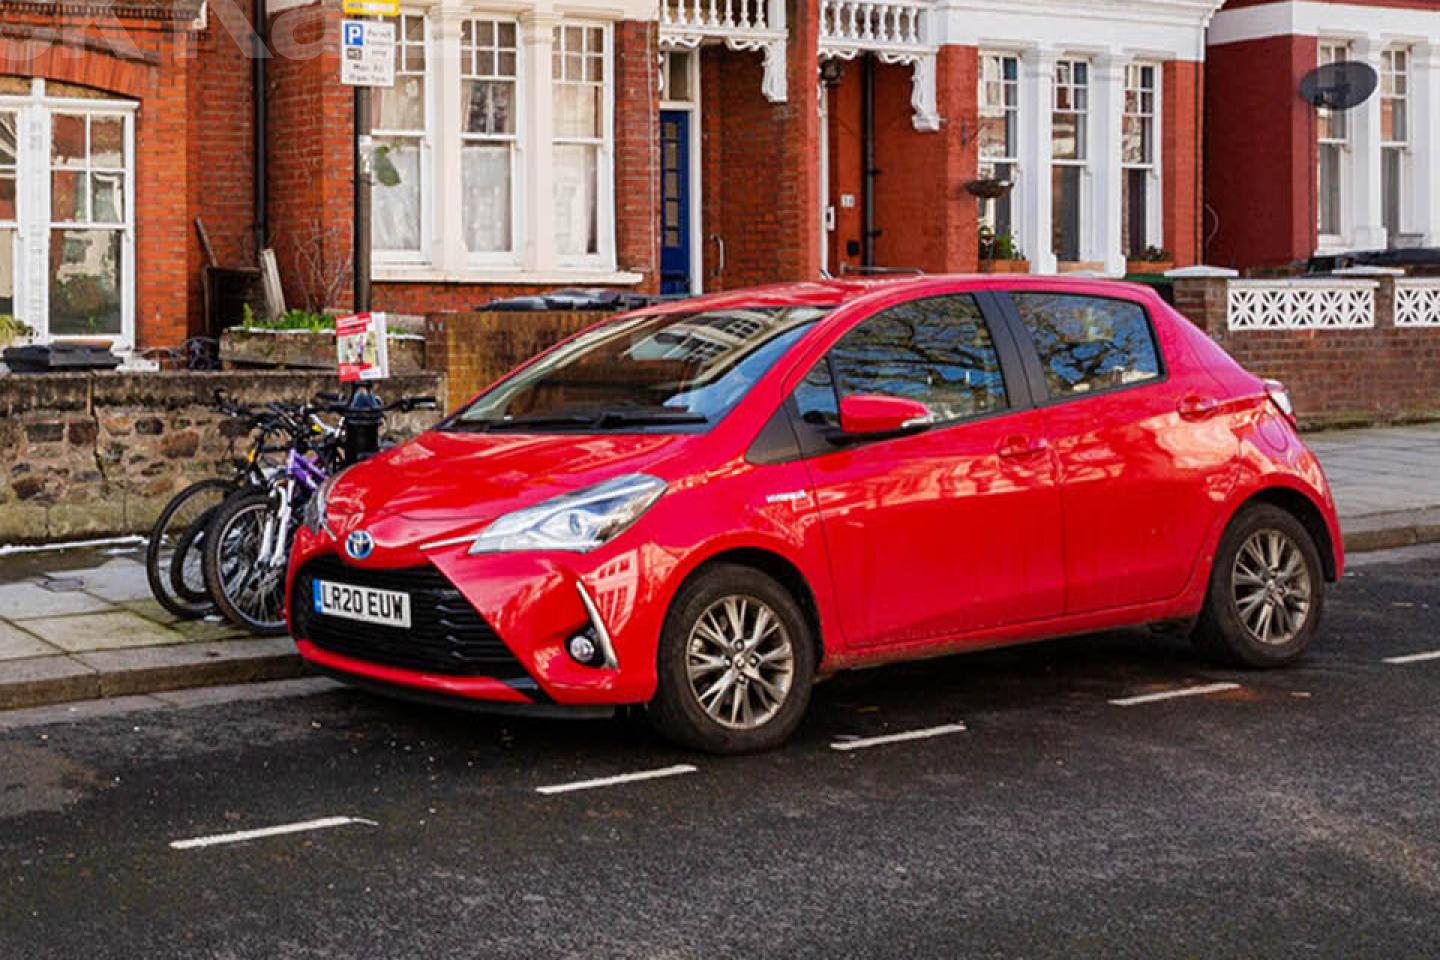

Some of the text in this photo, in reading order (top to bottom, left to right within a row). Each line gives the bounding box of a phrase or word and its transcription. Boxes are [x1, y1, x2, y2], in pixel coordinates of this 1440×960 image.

[348, 26, 361, 44] P
[322, 584, 403, 621] LR20 EUW
